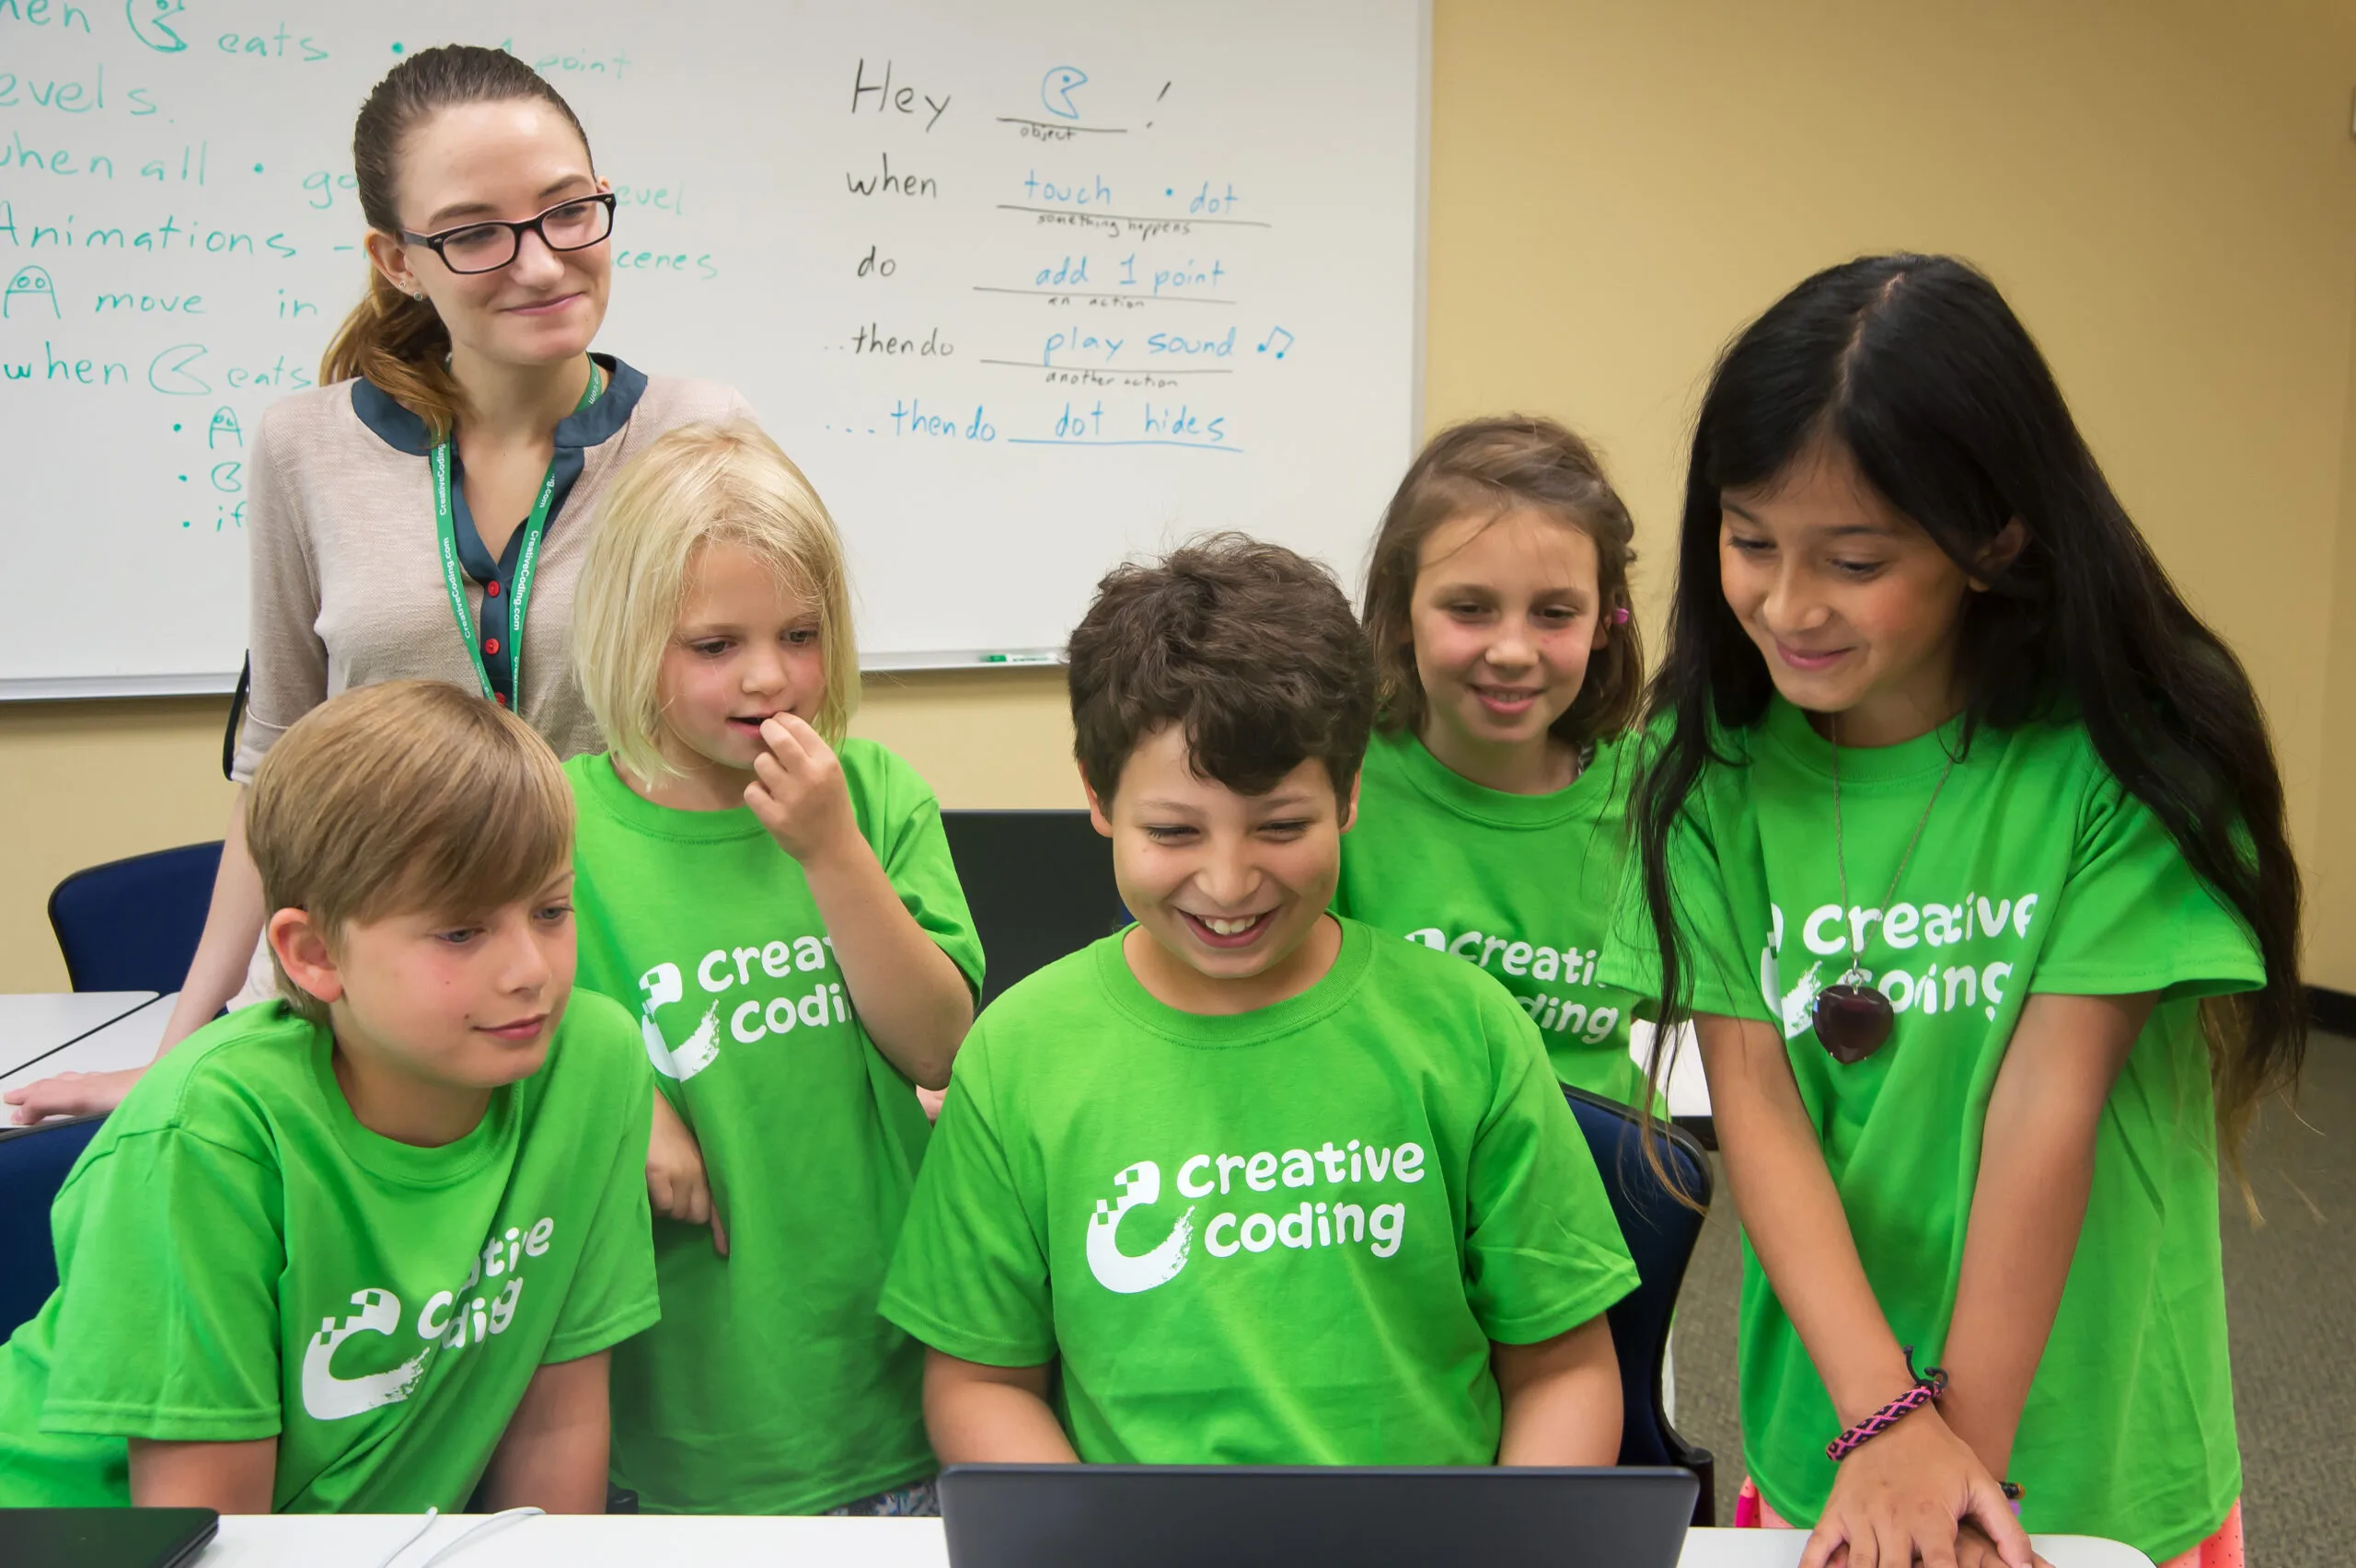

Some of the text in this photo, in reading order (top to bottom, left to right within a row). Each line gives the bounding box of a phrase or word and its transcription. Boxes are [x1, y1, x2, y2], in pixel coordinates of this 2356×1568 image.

[218, 21, 329, 62] eats
[851, 58, 952, 132] Hey
[1020, 124, 1078, 142] object
[141, 140, 208, 186] all
[847, 152, 1240, 214] when touch dot
[1037, 213, 1191, 241] something happens
[611, 250, 718, 280] cenes
[857, 246, 1225, 295] do add 1 point
[95, 288, 318, 319] move in
[1090, 295, 1145, 309] action
[4, 340, 312, 390] when eats
[1044, 327, 1124, 366] play
[1147, 327, 1237, 357] sound
[1046, 369, 1115, 387] another
[1055, 400, 1104, 438] dot
[1145, 402, 1226, 442] hides
[444, 536, 471, 639] CreativeCoding.com
[514, 530, 539, 631] CreativeCoding.com
[698, 935, 832, 993] crea
[1449, 930, 1607, 988] creati
[730, 982, 852, 1043] codi
[1176, 1139, 1425, 1199] creative
[1204, 1201, 1405, 1259] coding
